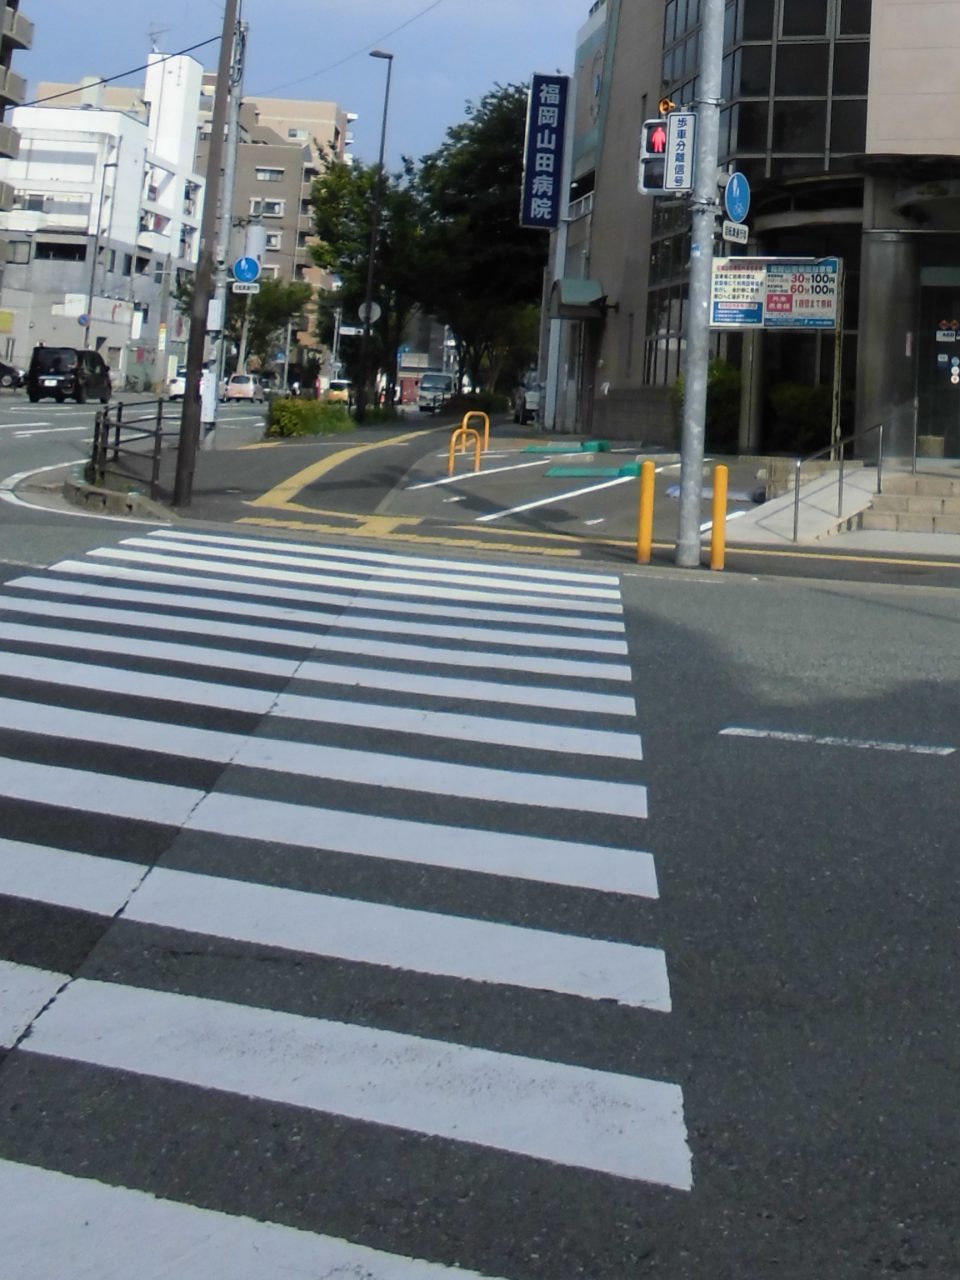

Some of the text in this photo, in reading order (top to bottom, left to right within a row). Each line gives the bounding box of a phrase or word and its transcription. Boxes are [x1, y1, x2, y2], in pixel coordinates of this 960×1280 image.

[530, 82, 560, 220] 福岡山田病院
[674, 117, 688, 187] 歩車分離信号
